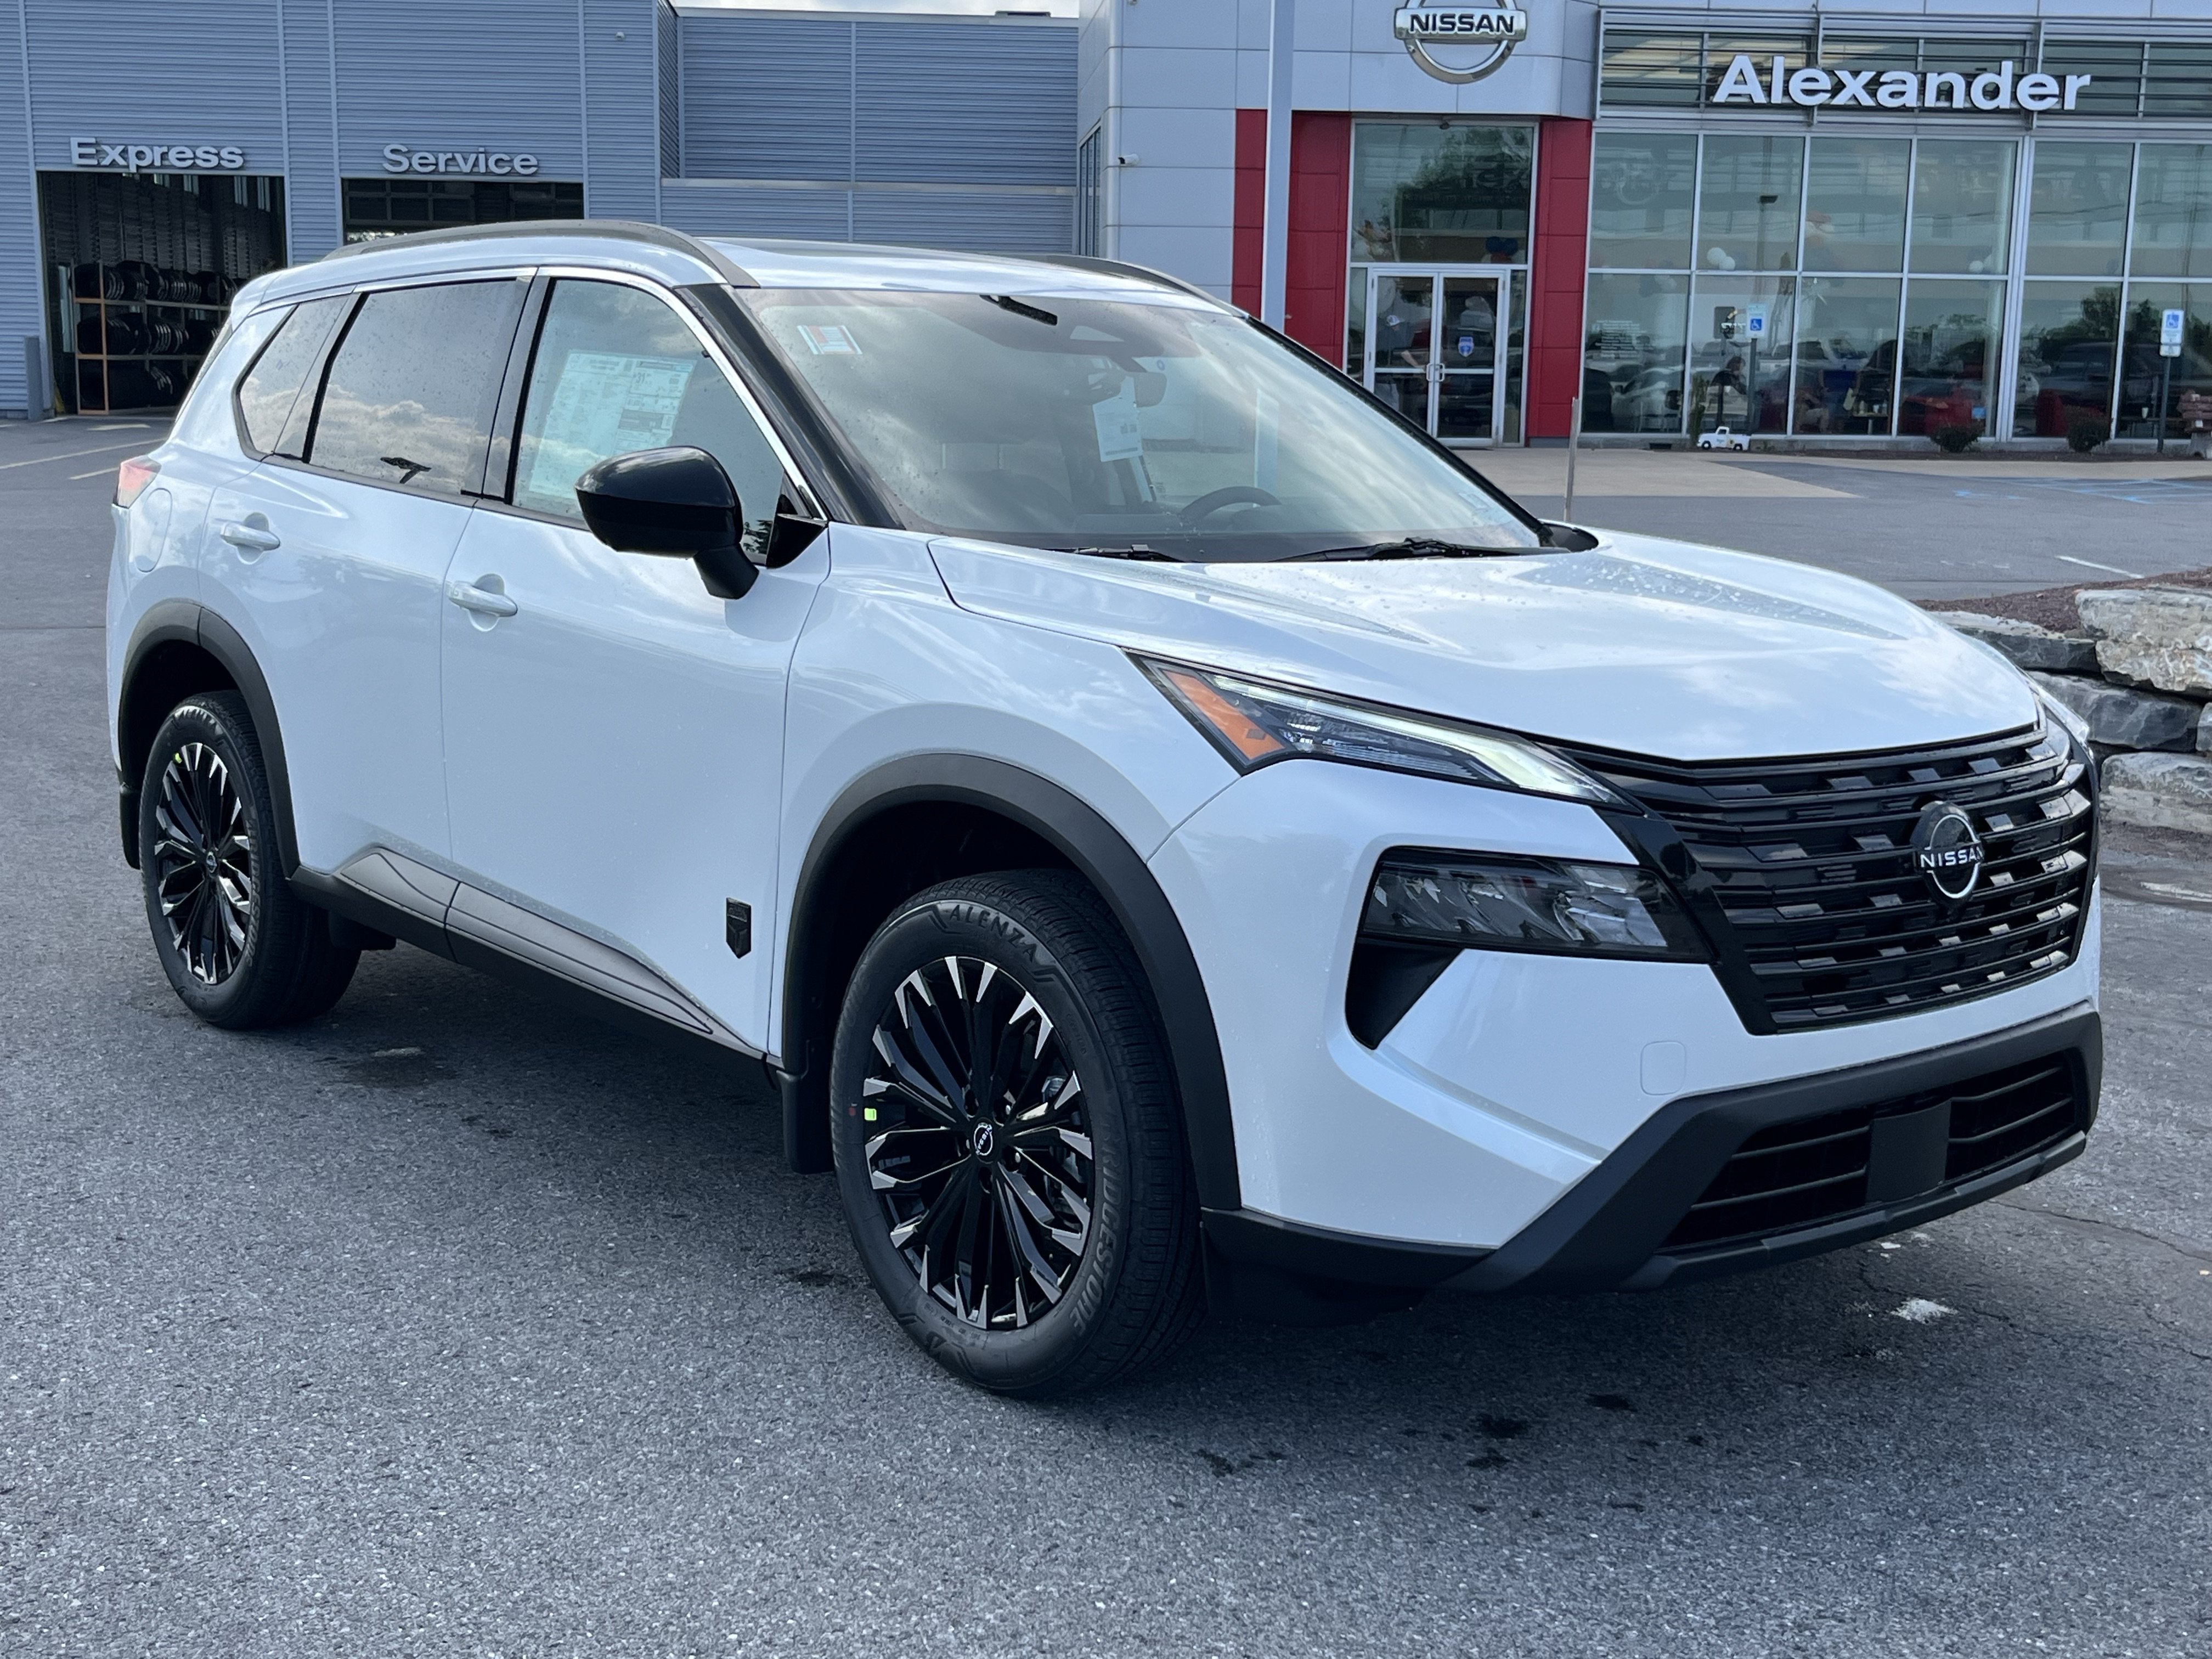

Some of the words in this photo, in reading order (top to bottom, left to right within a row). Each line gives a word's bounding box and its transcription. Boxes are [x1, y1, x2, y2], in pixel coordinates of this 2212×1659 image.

[1409, 13, 1515, 33] NISSAN
[1712, 54, 2092, 110] Alexander
[70, 136, 245, 173] Express
[383, 143, 539, 176] Service
[1920, 846, 1984, 868] NISSAN
[949, 904, 1037, 963] ALENZA
